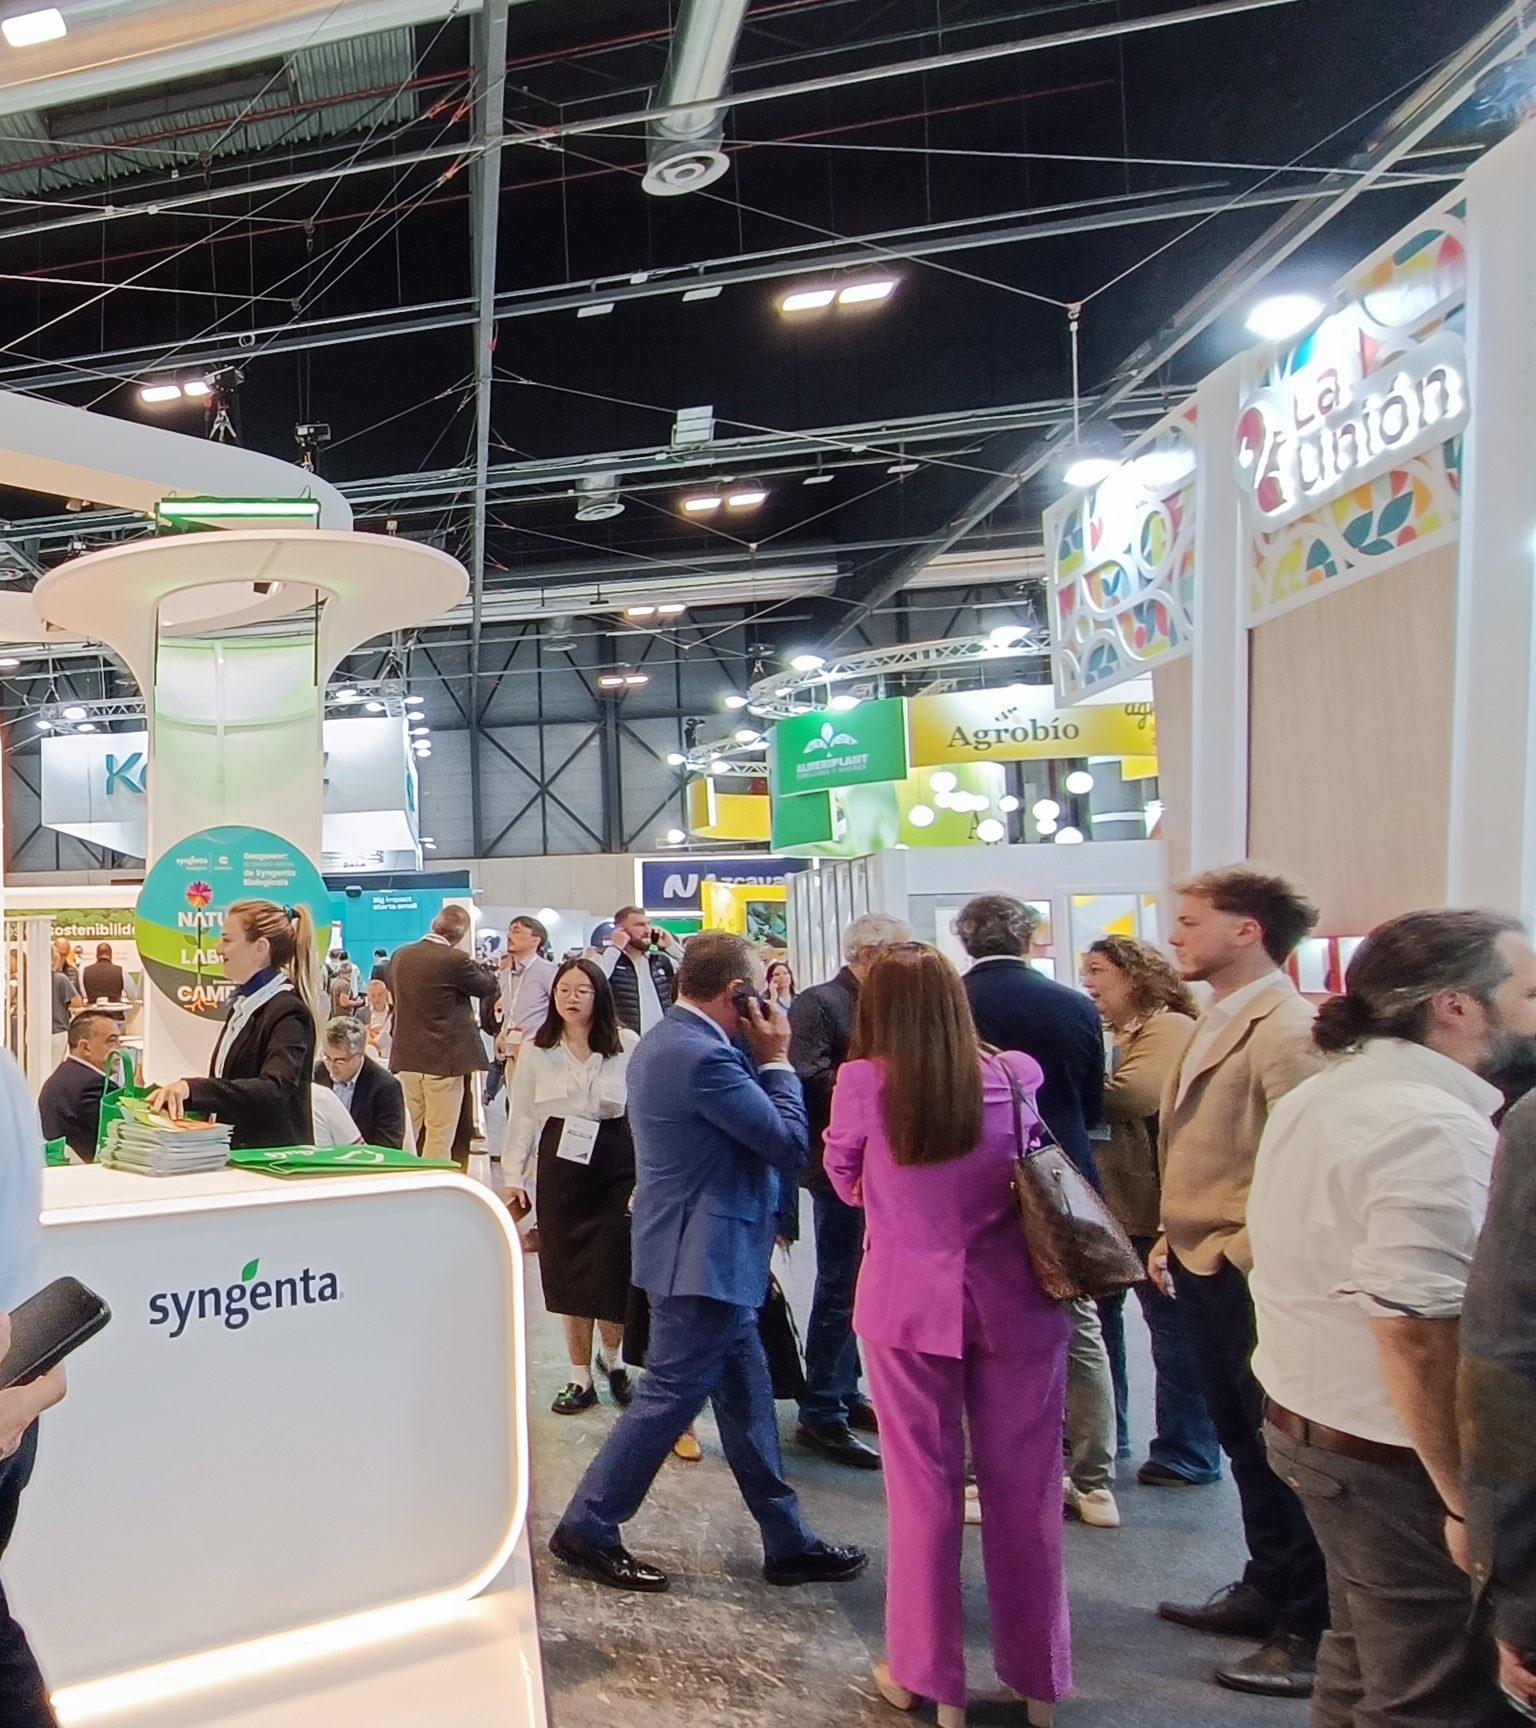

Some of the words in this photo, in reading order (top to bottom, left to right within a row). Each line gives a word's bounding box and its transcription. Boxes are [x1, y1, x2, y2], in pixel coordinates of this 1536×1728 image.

[946, 717, 1080, 752] Agrobío
[255, 869, 296, 879] Syngenta
[181, 949, 224, 965] LAB
[149, 1267, 338, 1338] syngenta
